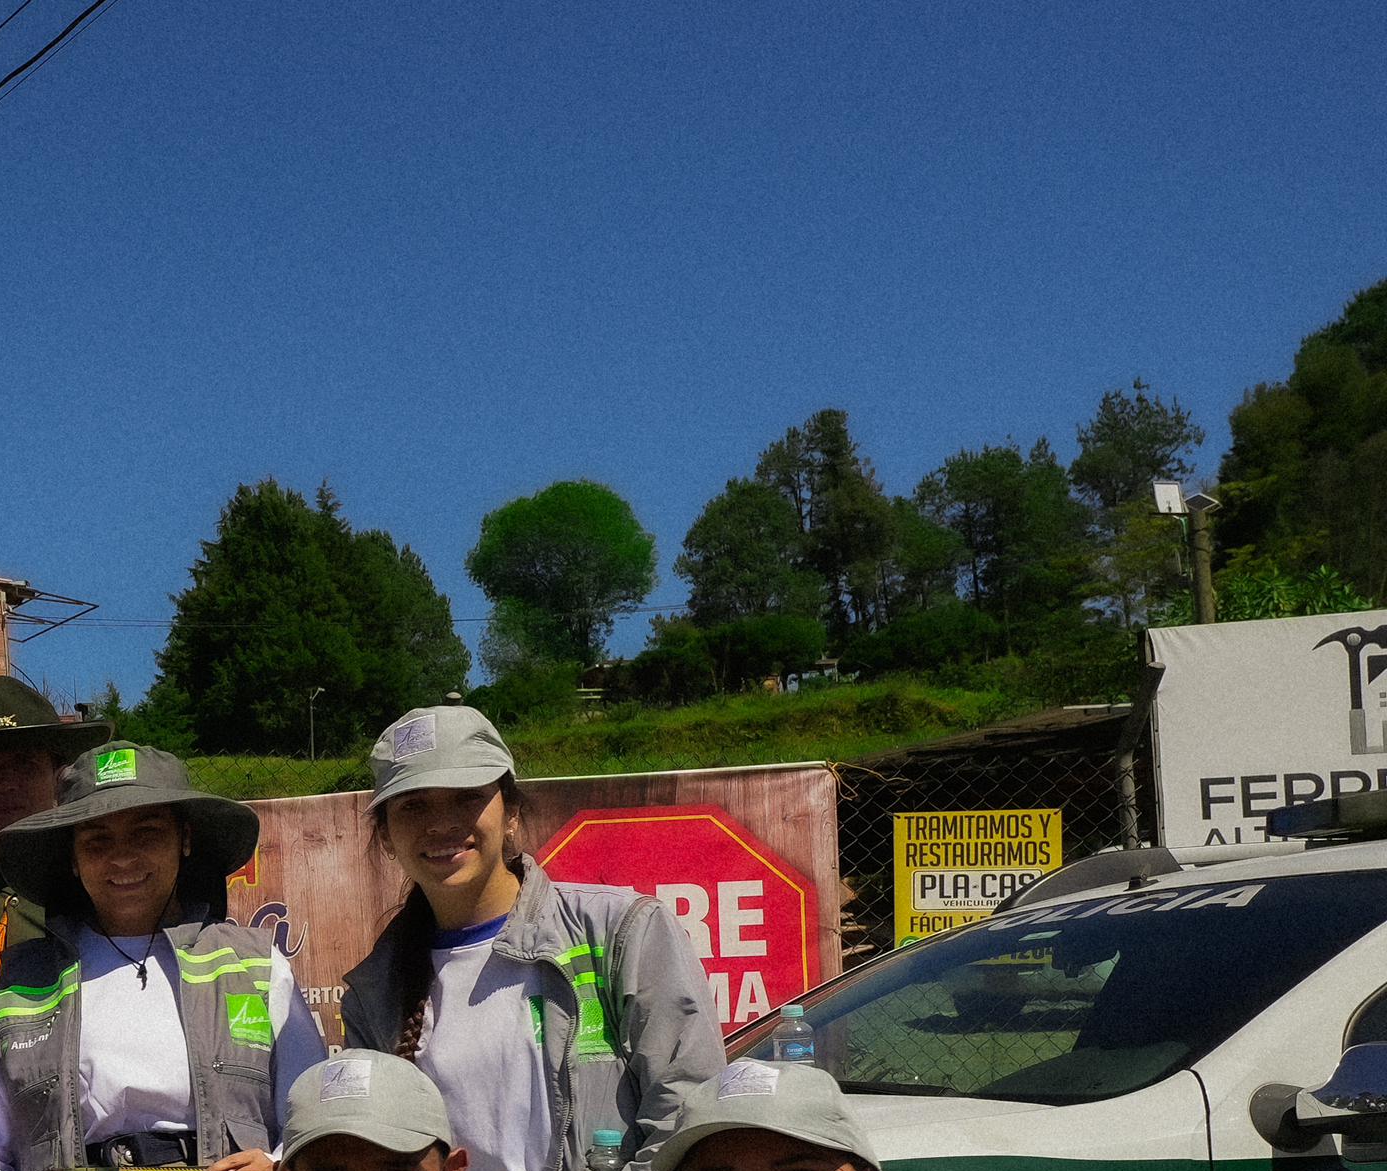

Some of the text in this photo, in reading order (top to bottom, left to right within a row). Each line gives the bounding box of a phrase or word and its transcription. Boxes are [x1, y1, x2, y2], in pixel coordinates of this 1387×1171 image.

[904, 814, 1051, 840] TRAMITAMOS Y
[905, 841, 1051, 867] RESTAURAMOS
